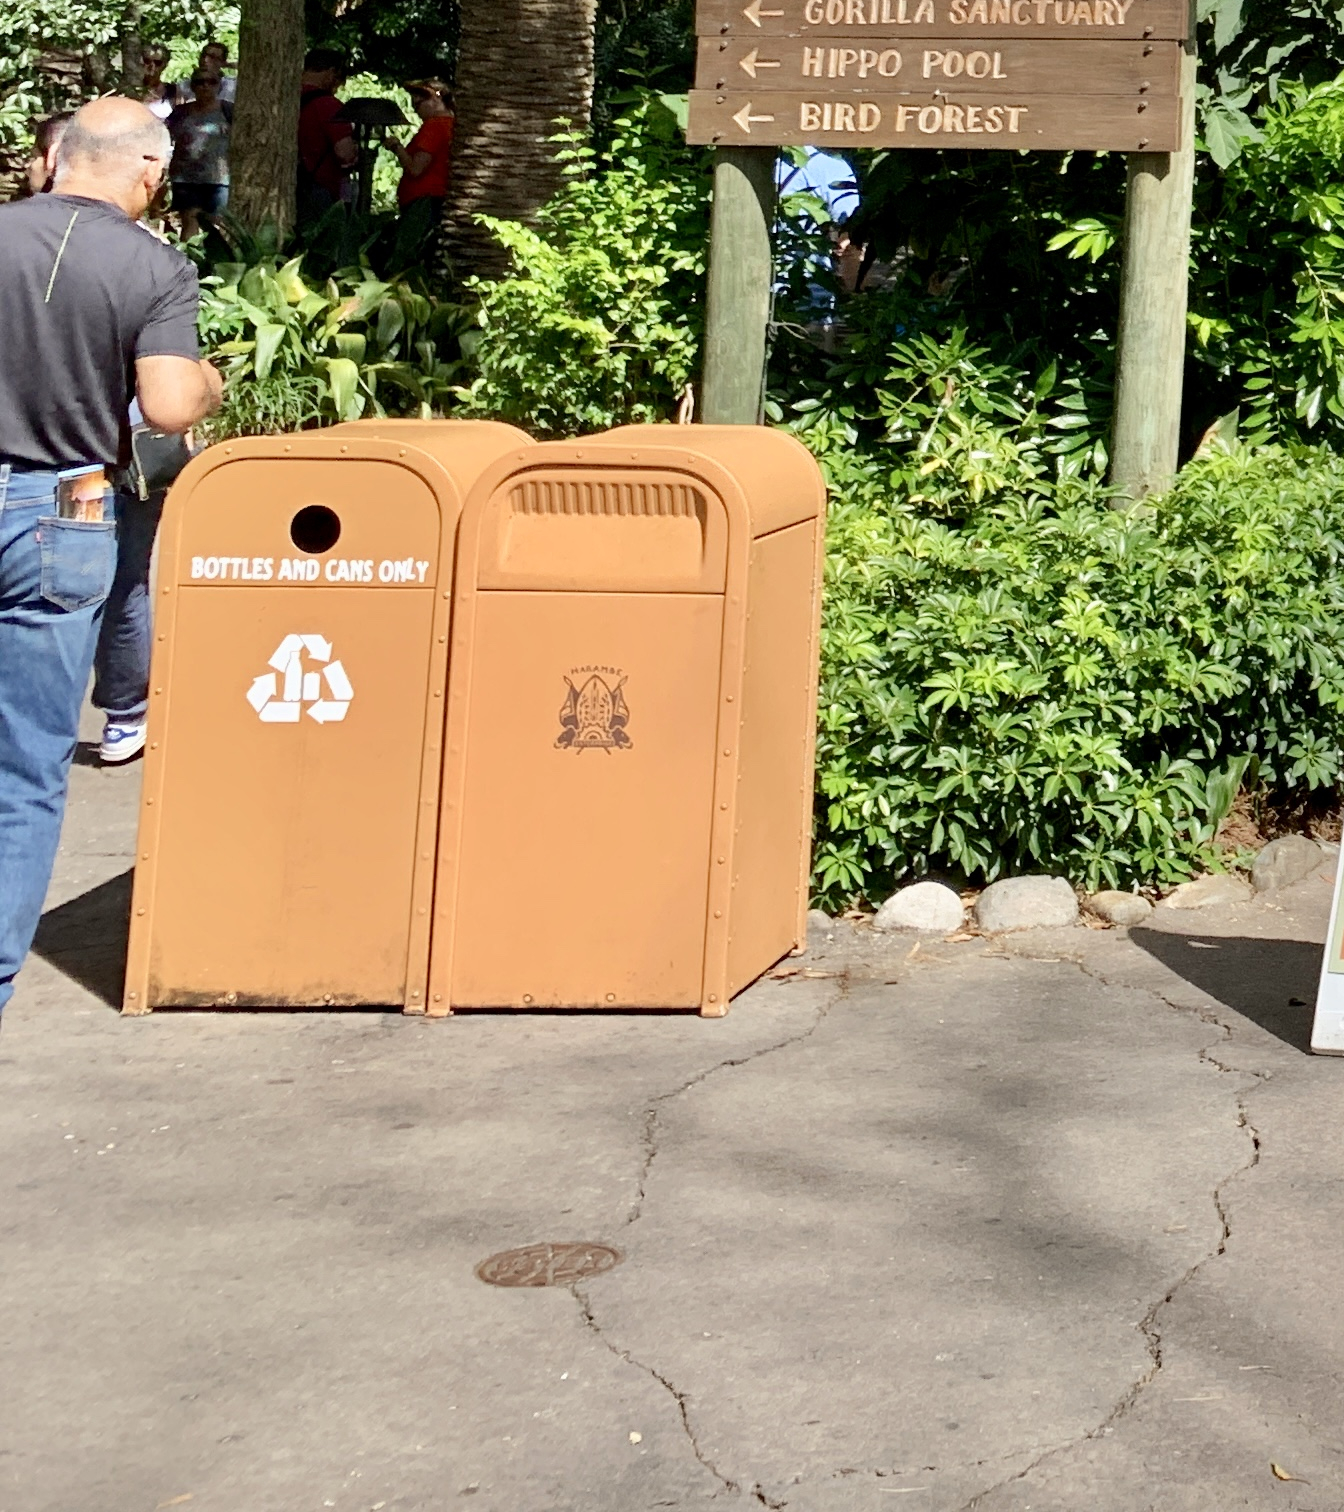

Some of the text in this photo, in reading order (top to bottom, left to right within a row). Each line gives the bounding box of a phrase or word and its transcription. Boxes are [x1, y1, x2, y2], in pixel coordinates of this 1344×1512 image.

[801, 47, 1008, 79] HIPPO POOL
[800, 102, 1028, 135] BIRD FOREST
[191, 555, 429, 584] BOTTLES AND CANS ONLY
